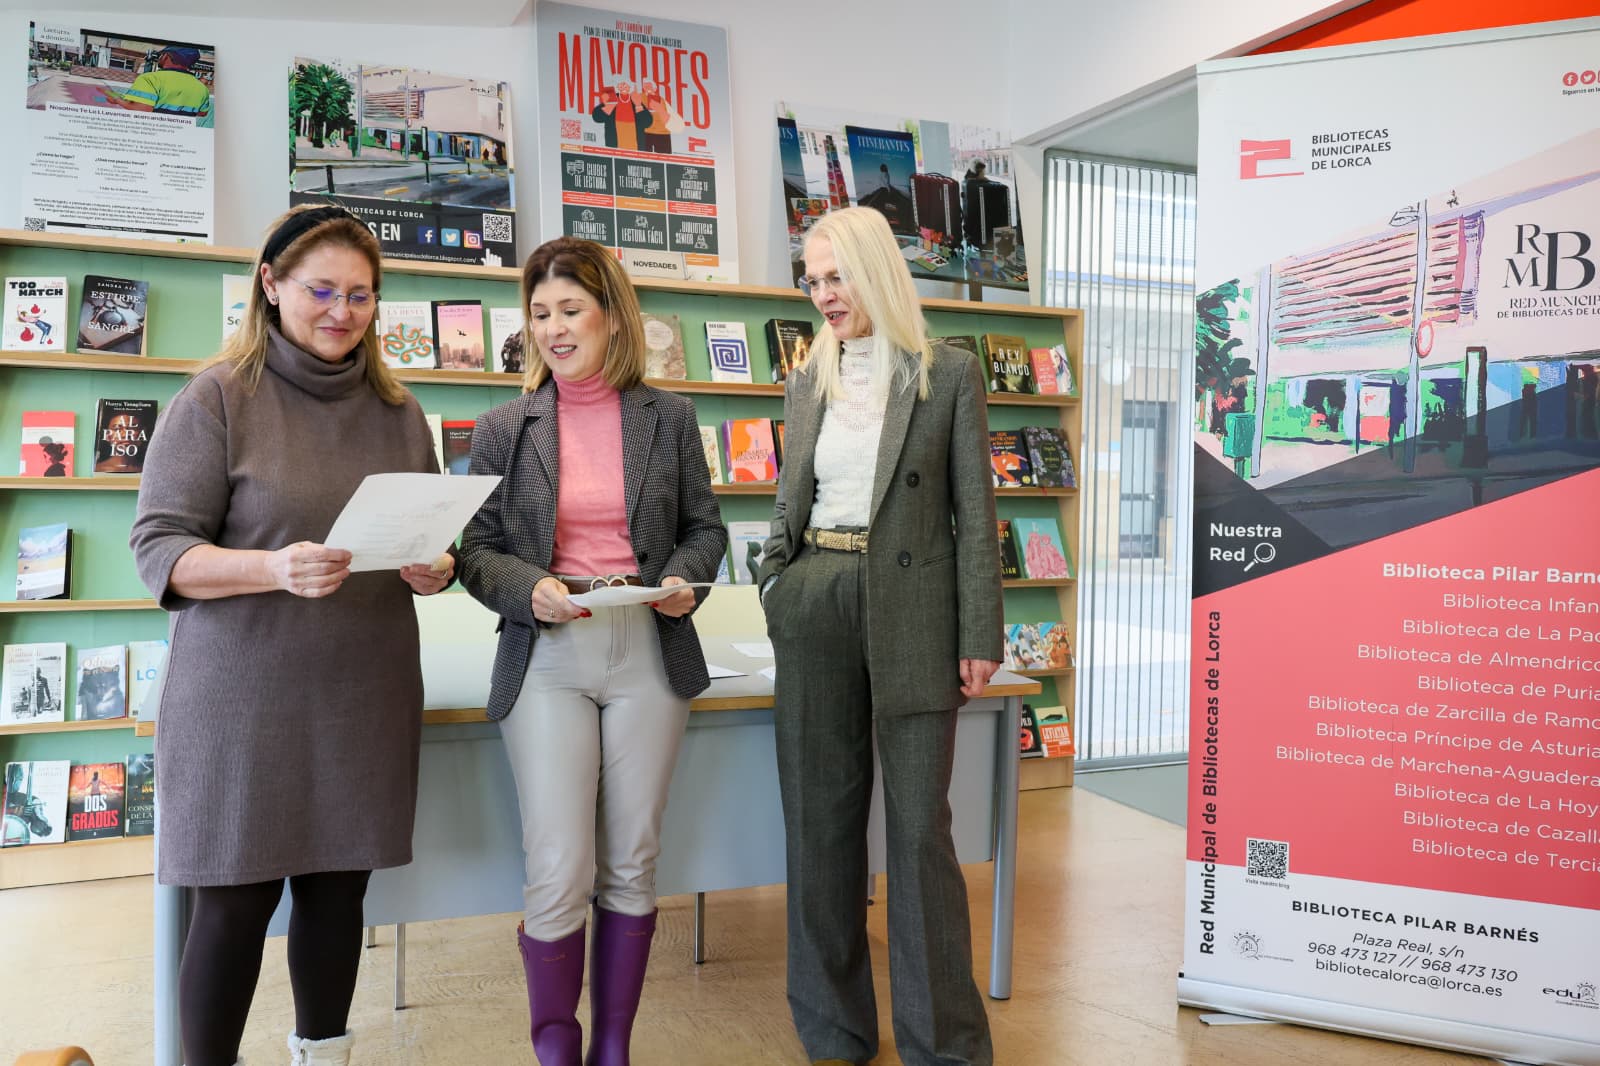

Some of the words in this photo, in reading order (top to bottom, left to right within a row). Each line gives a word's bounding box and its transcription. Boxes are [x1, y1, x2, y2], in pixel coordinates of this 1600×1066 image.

[558, 32, 710, 130] MAYORES
[857, 136, 910, 152] ITINERANTES
[1312, 128, 1389, 144] BIBLIOTECAS
[1312, 142, 1392, 158] MUNICIPALES
[1312, 160, 1328, 170] DE
[1331, 157, 1372, 169] LORCA
[584, 175, 607, 190] LECTURA
[400, 210, 424, 219] LORCA
[381, 222, 400, 242] EN
[622, 228, 646, 243] LECTURA
[648, 226, 664, 245] FÁCIL
[633, 260, 678, 270] NOVEDADES
[9, 281, 36, 289] TOO
[91, 290, 142, 304] ESTIRPE
[1510, 297, 1538, 309] RED
[1497, 310, 1510, 319] DE
[1512, 308, 1574, 318] BIBLIOTECAS
[1576, 307, 1589, 316] DE
[88, 321, 136, 334] SANGRE
[998, 346, 1020, 360] REY
[994, 361, 1030, 376] BLANCO
[119, 415, 139, 428] AL
[102, 428, 148, 442] PARA
[1210, 522, 1282, 539] Nuestra
[1210, 546, 1246, 562] Red
[1383, 563, 1485, 580] Biblioteca
[1492, 566, 1540, 582] Pilar
[1443, 594, 1542, 612] Biblioteca
[1206, 611, 1220, 662] Lorca
[1403, 620, 1499, 638] Biblioteca
[1506, 624, 1531, 639] de
[1538, 626, 1561, 640] La
[1358, 644, 1452, 664] Biblioteca
[1458, 650, 1482, 666] de
[1205, 668, 1220, 690] de
[1418, 676, 1514, 696] Biblioteca
[1521, 682, 1546, 697] de
[1308, 696, 1400, 716] Biblioteca
[1406, 703, 1430, 718] de
[1436, 704, 1506, 723] Zarcilla
[1512, 710, 1538, 725] de
[1203, 697, 1218, 796] Bibliotecas
[1316, 723, 1408, 744] Biblioteca
[1414, 730, 1492, 752] Príncipe
[1498, 737, 1523, 752] de
[1276, 746, 1364, 768] Biblioteca
[1371, 754, 1394, 769] de
[84, 795, 107, 812] DOS
[1394, 783, 1490, 805] Biblioteca
[1496, 792, 1521, 808] de
[1528, 795, 1551, 810] La
[72, 810, 119, 832] GRADOS
[1202, 803, 1216, 824] de
[1404, 810, 1499, 834] Biblioteca
[1506, 821, 1530, 836] de
[1537, 824, 1600, 844] Cazall
[1412, 839, 1508, 863] Biblioteca
[1514, 850, 1540, 865] de
[1201, 831, 1218, 914] Municipal
[1292, 900, 1396, 924] BIBLIOTECA
[1404, 914, 1456, 932] PILAR
[1464, 922, 1540, 943] BARNÉS
[1200, 920, 1214, 954] Red
[1352, 932, 1392, 948] Plaza
[1397, 938, 1433, 956] Real,
[1438, 944, 1465, 958] s/n
[1308, 942, 1336, 956] 968
[1340, 948, 1368, 961] 473
[1373, 951, 1397, 964] 127
[1398, 954, 1419, 968] //
[1422, 958, 1452, 973] 968
[1456, 964, 1486, 978] 473
[1491, 968, 1518, 982] 130
[1315, 958, 1503, 998] bibliotecalorca@lorca.es
[1542, 988, 1580, 1000] edu
